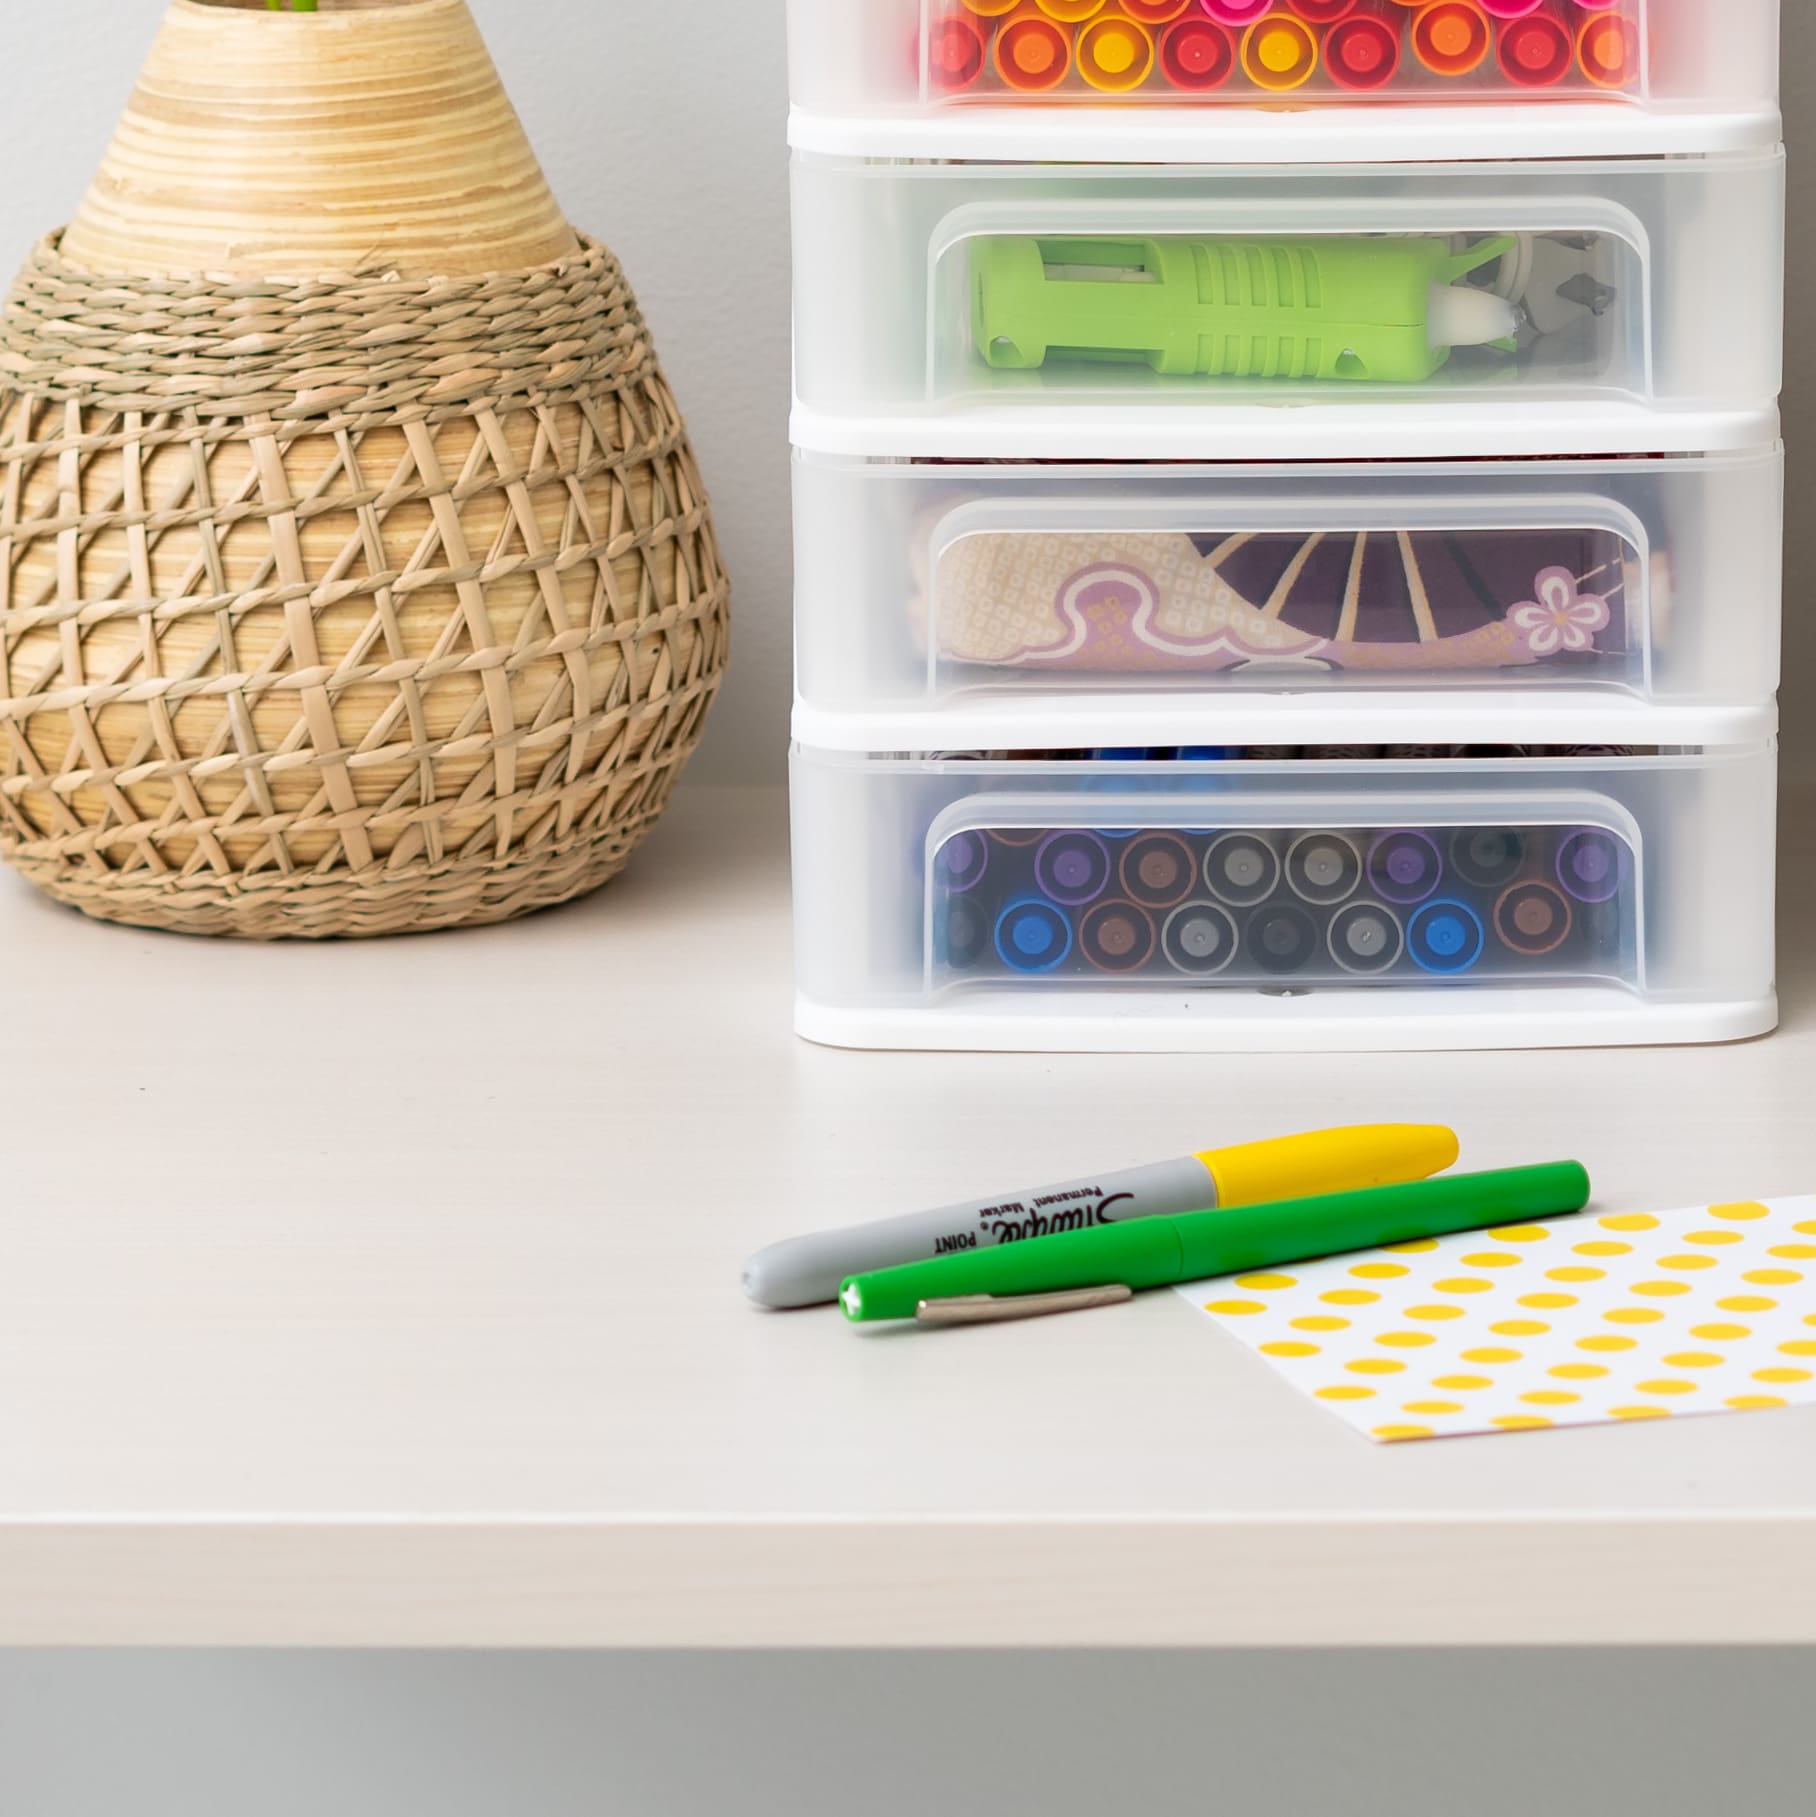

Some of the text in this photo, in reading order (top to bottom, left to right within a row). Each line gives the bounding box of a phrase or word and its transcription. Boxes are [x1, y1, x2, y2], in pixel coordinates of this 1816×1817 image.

[978, 1186, 1103, 1218] Permanent Marker
[934, 1231, 977, 1255] POINT
